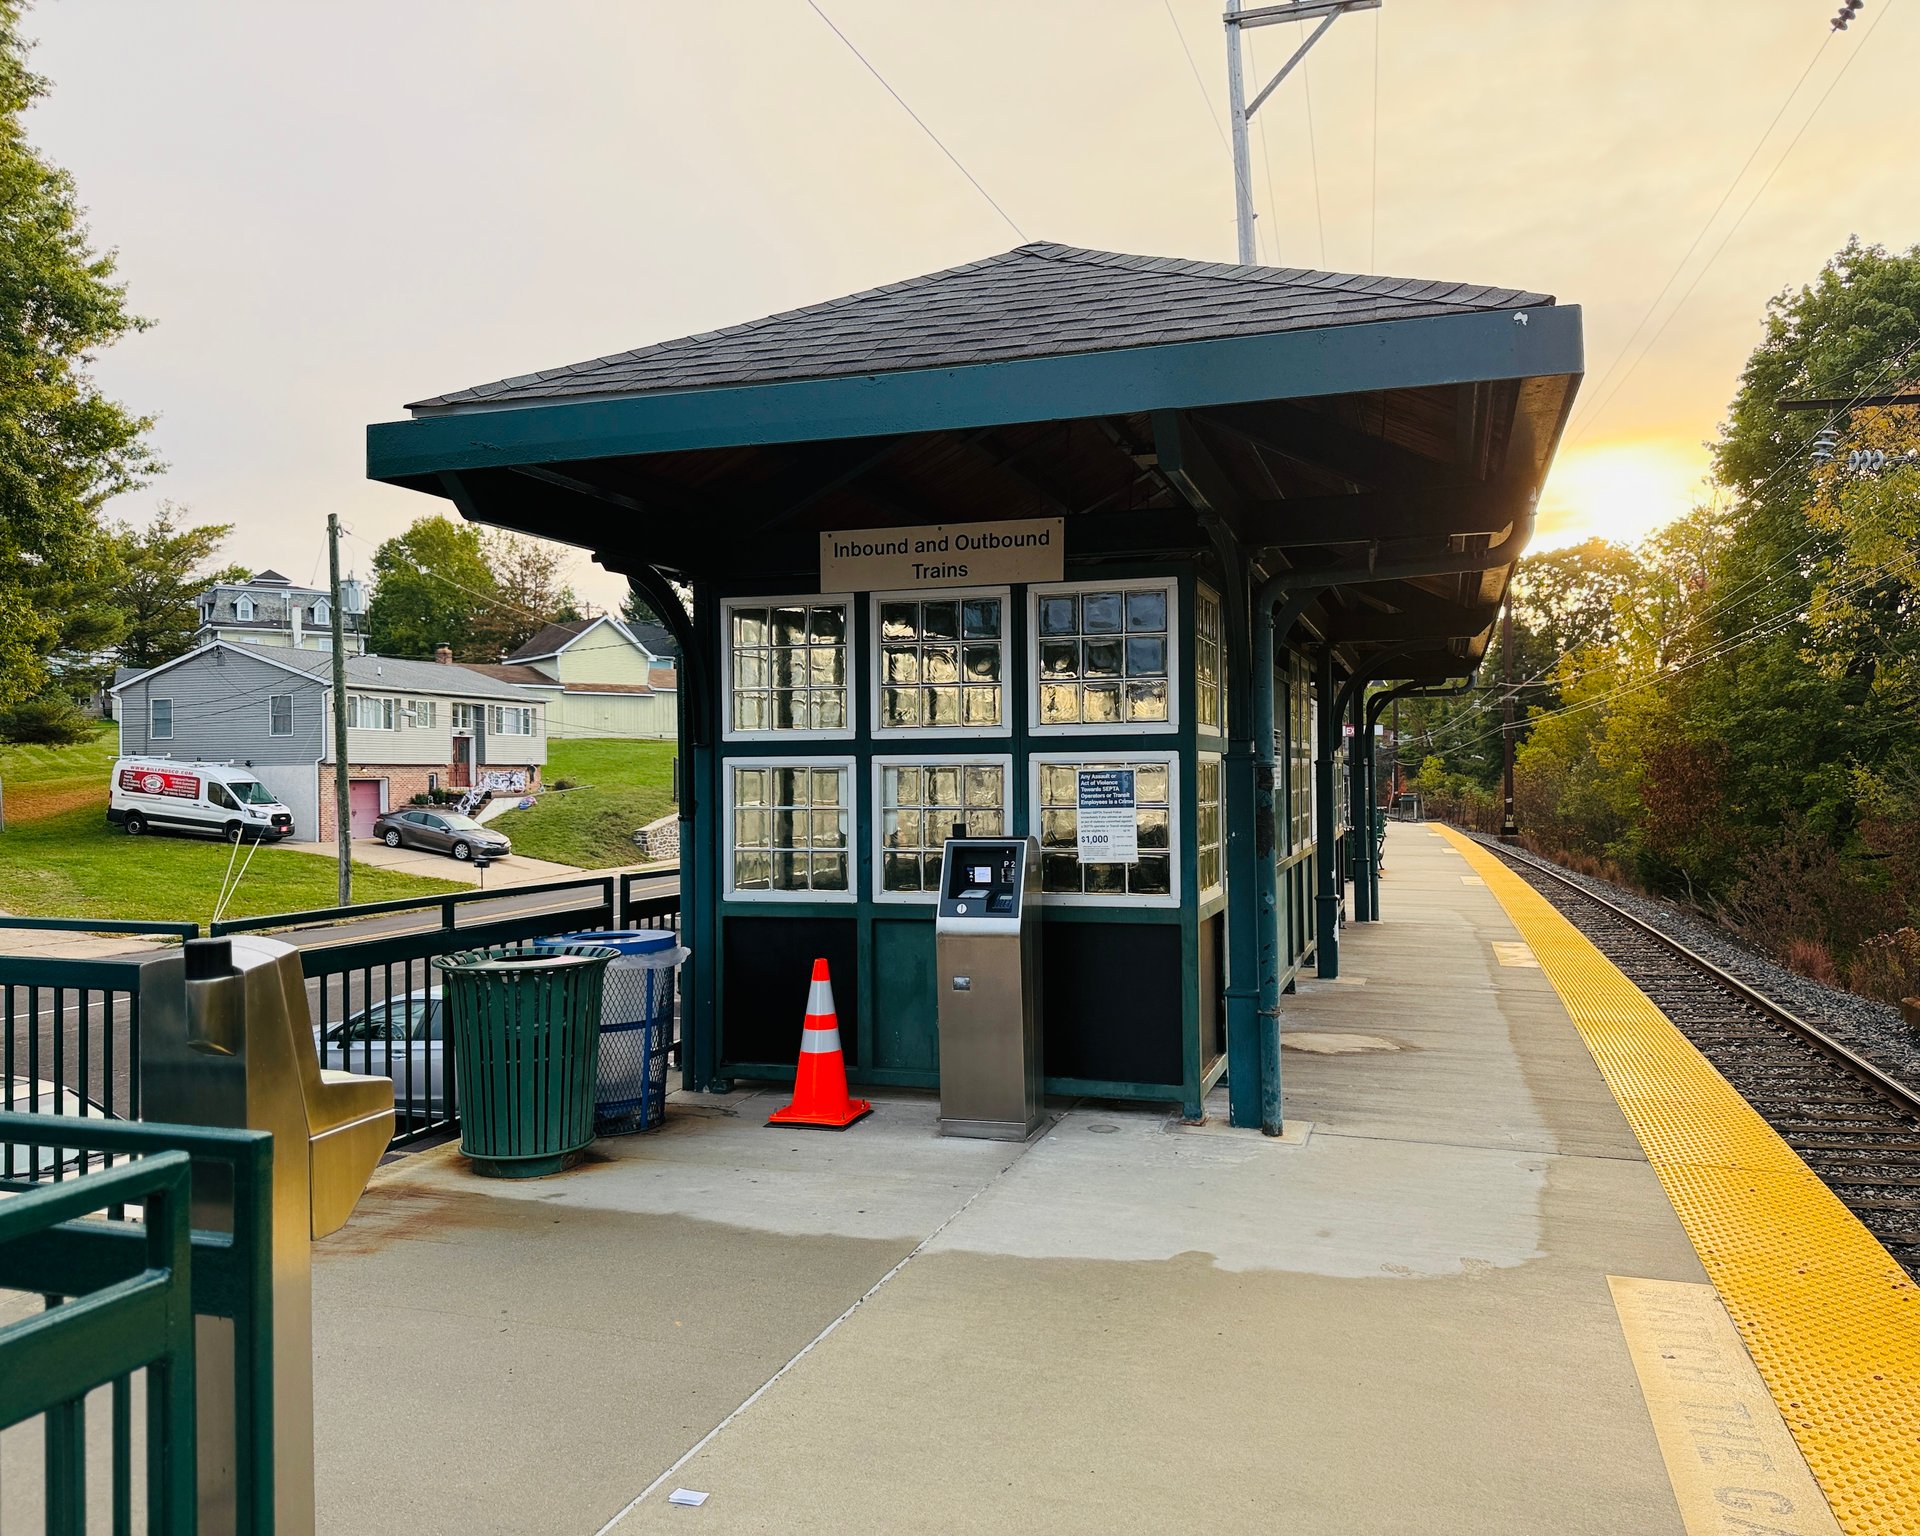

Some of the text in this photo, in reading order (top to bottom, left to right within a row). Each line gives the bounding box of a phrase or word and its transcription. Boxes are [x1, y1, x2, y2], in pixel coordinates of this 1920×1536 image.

[833, 529, 1050, 558] Inbound and Outbound
[911, 562, 969, 580] Trains
[1081, 834, 1109, 845] $1,000
